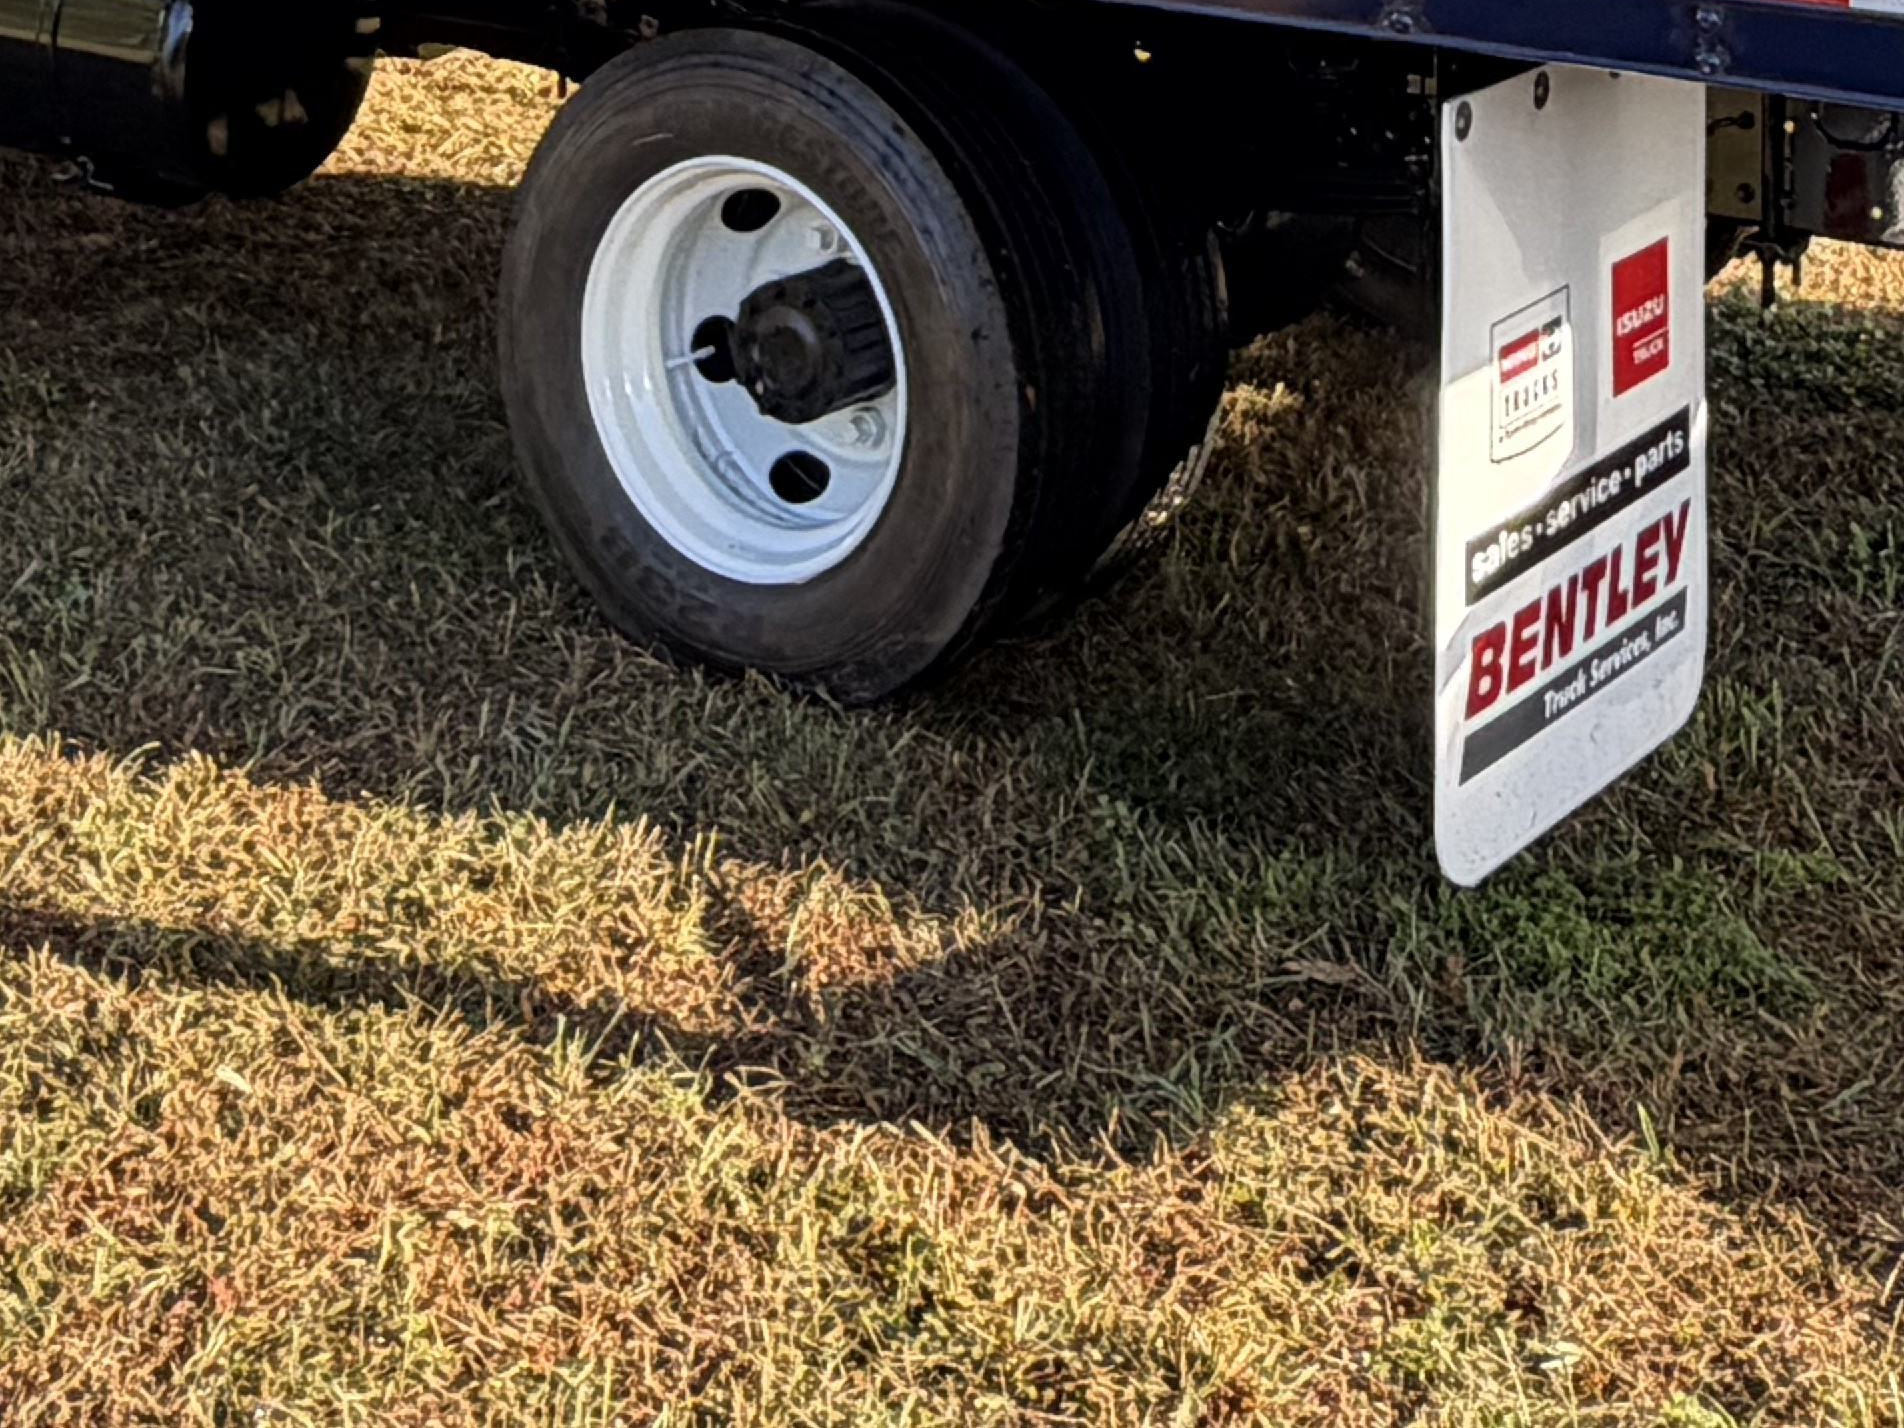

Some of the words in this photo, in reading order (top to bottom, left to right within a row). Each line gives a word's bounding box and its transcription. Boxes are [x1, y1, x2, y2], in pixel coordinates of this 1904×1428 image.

[1616, 294, 1665, 337] ISUZU
[1472, 523, 1533, 584] sales
[1545, 467, 1622, 535] service
[1634, 429, 1684, 487] parts
[1465, 496, 1691, 721] BENTLEY
[1544, 672, 1586, 719] Truck
[1589, 628, 1651, 689] Services,
[1654, 607, 1679, 642] Inc.
